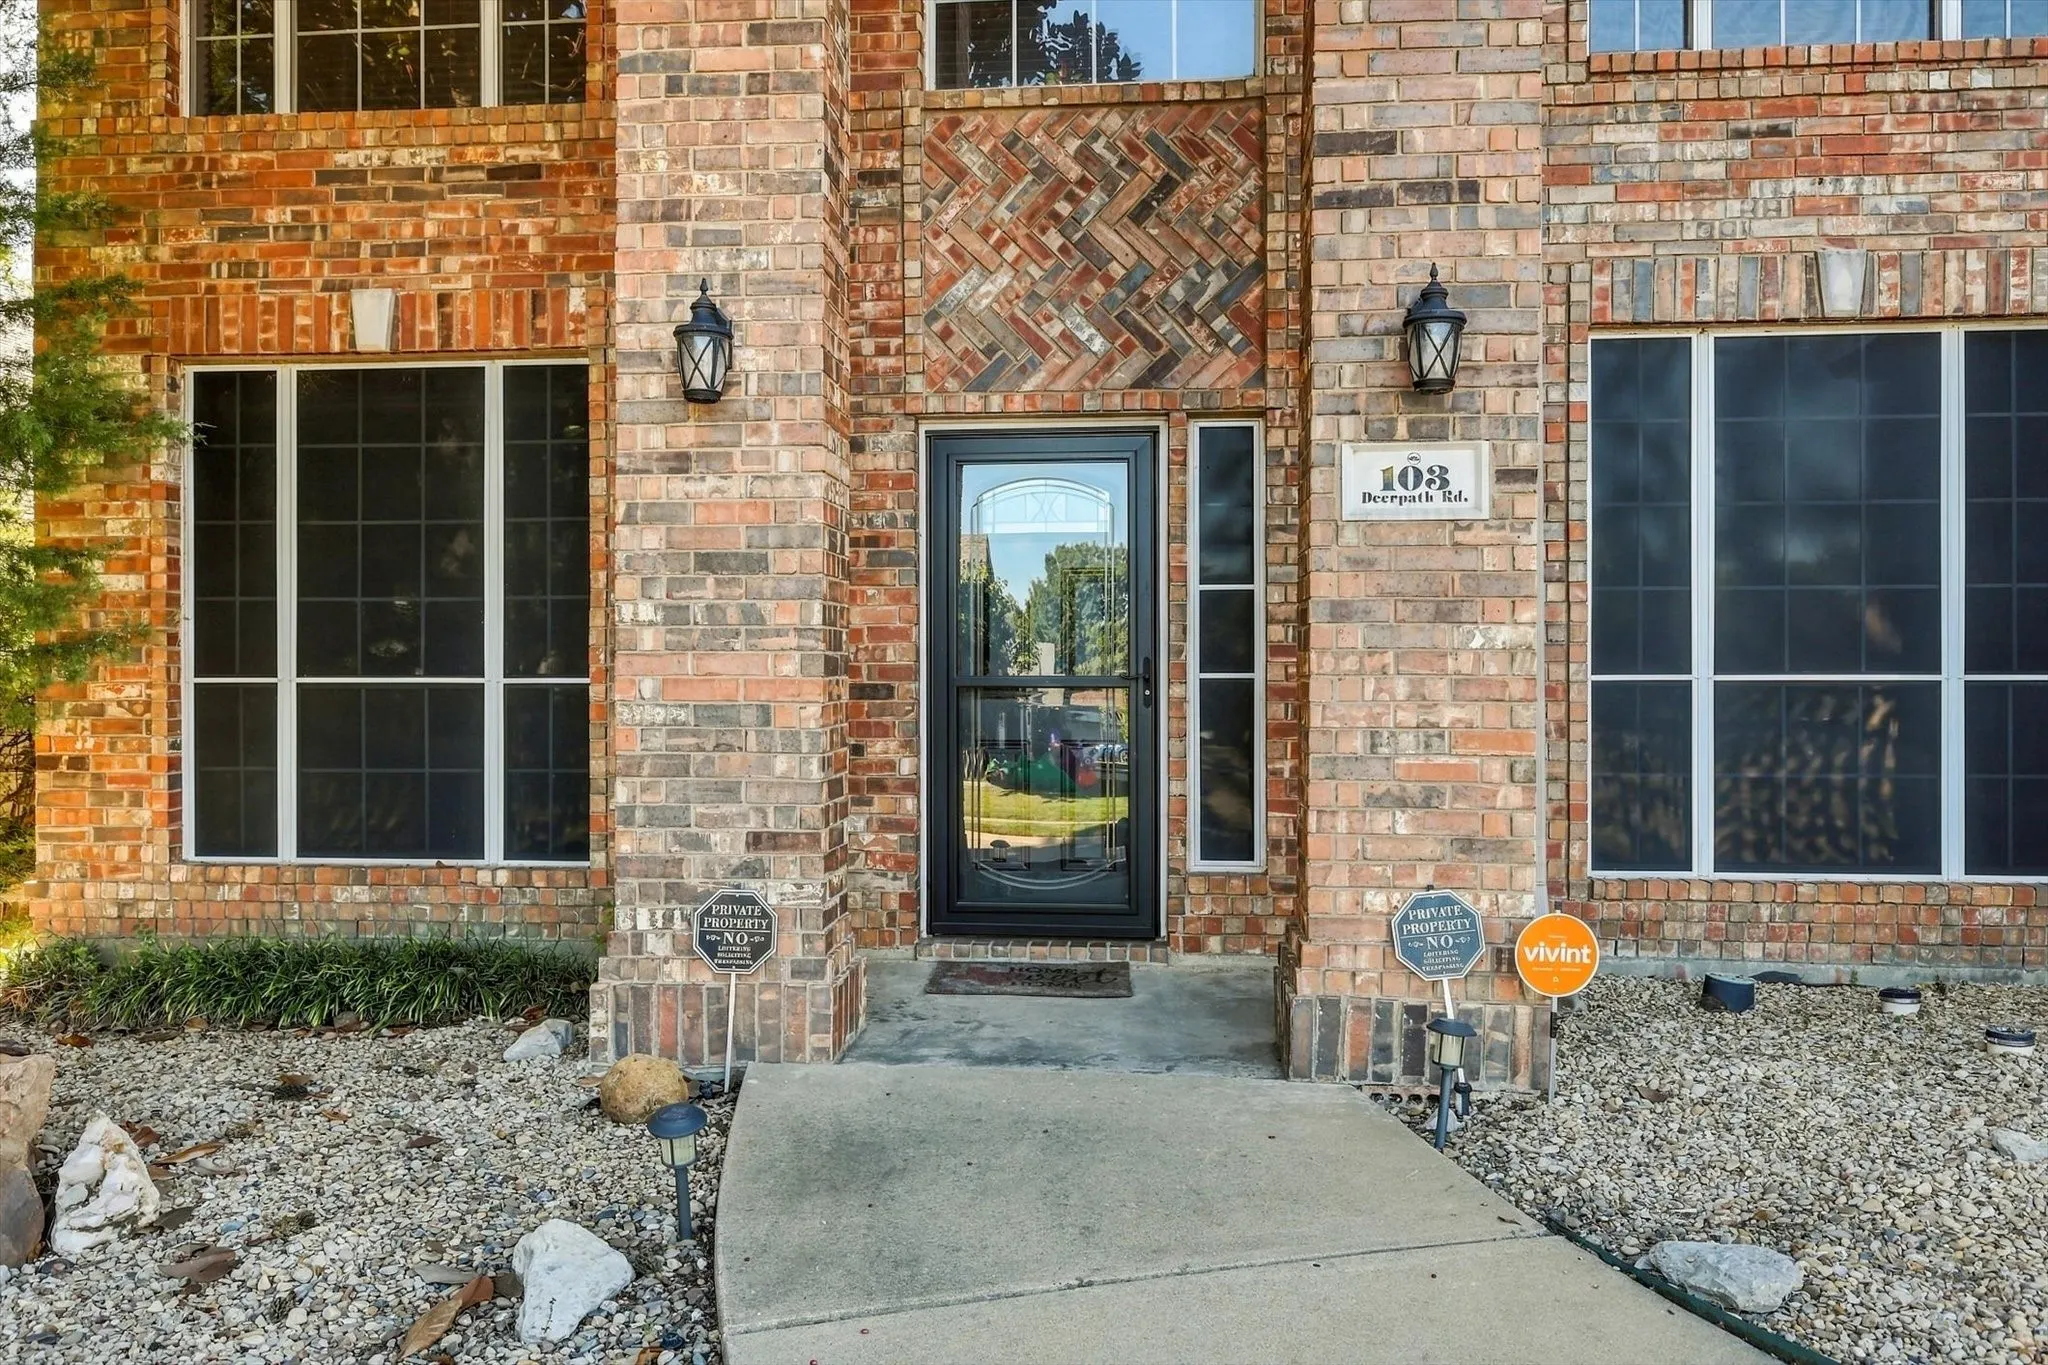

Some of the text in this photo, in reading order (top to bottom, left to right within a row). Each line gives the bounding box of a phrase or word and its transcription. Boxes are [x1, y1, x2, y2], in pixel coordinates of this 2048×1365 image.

[1380, 464, 1450, 491] 103
[1361, 490, 1468, 506] Deerpath Rd.
[711, 904, 762, 916] PRIVATE
[1408, 904, 1463, 920] PRIVATE
[703, 917, 769, 929] PROPERTY
[1402, 918, 1471, 935] PROPERTY
[723, 932, 748, 945] NO
[1426, 934, 1453, 949] NO
[1423, 949, 1459, 957] LOITERING
[1523, 941, 1592, 964] vivint
